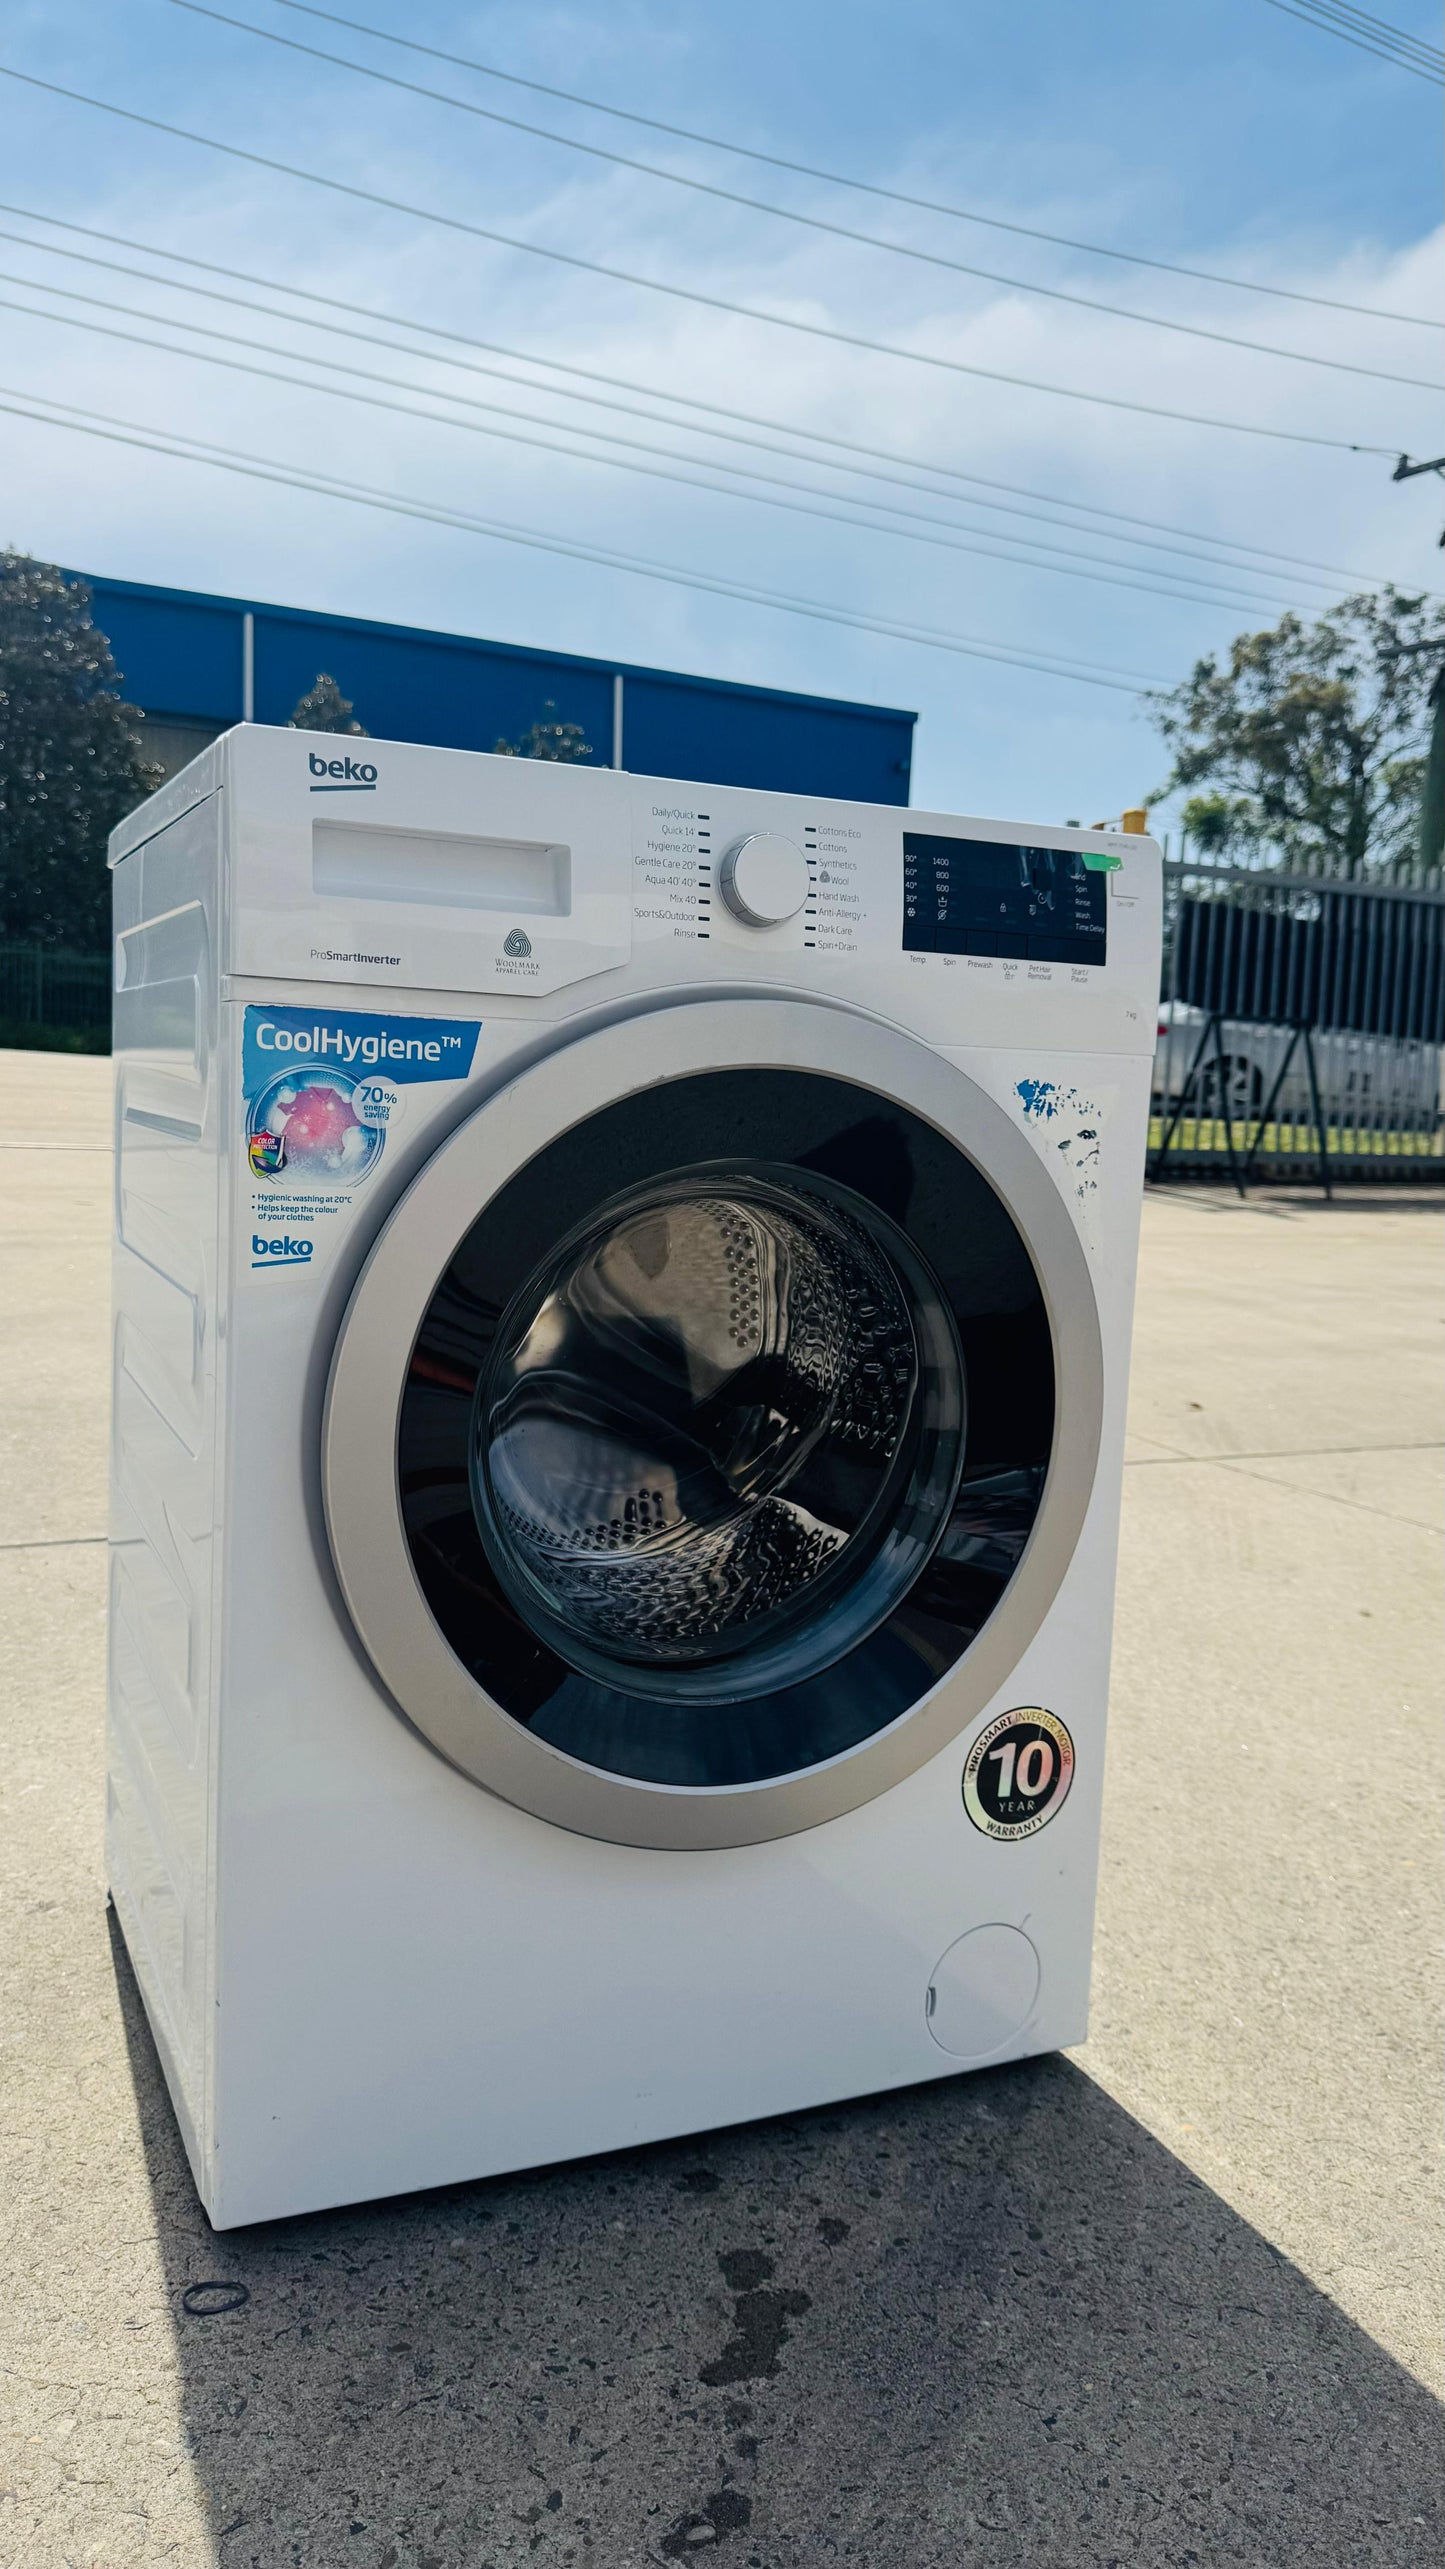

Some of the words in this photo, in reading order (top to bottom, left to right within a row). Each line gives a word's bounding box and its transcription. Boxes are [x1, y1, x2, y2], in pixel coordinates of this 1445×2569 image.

[308, 753, 378, 783] beko
[652, 806, 694, 820] Daily/Quick
[661, 824, 683, 836] Quick
[818, 825, 847, 837] Cottons
[848, 829, 861, 839] Eco
[647, 840, 681, 852] Hygiene
[681, 843, 696, 853] 20°
[818, 841, 848, 853] Cottons
[634, 855, 662, 867] Gentle
[662, 858, 681, 869] Care
[681, 860, 697, 870] 20°
[818, 857, 858, 871] Synthetics
[932, 857, 950, 867] 1400
[644, 874, 666, 886] Aqua
[831, 875, 850, 886] Wool
[935, 870, 950, 880] 800
[935, 883, 950, 893] 600
[1074, 885, 1088, 894] Spin
[669, 893, 684, 904] Mix
[684, 895, 697, 905] 40
[818, 891, 839, 901] Hand
[839, 893, 860, 903] Wash
[1074, 898, 1091, 907] Rinse
[633, 907, 695, 921] Sports&Outdoor
[818, 907, 861, 921] Anti-Allergy
[1074, 911, 1091, 920] Wash
[673, 927, 696, 939] Rinse
[818, 923, 835, 934] Dark
[835, 925, 853, 936] Care
[1075, 923, 1089, 932] Time
[1089, 924, 1106, 935] Delay
[817, 939, 858, 952] Spin+Drain
[310, 949, 401, 966] ProSmartInverter
[943, 957, 957, 967] Spin
[495, 958, 541, 971] WOOLMARK
[967, 959, 993, 969] Prewash
[1002, 962, 1018, 972] Quick
[1028, 964, 1039, 973] Pet
[495, 967, 521, 976] APPAREL
[523, 968, 539, 977] CARE
[1027, 972, 1052, 982] Removal
[1070, 975, 1088, 984] Pause
[360, 1086, 397, 1105] 70%
[363, 1104, 391, 1113] energy
[363, 1110, 390, 1120] saving
[257, 1137, 276, 1145] COLOR
[257, 1193, 292, 1203] Hygienic
[292, 1195, 325, 1204] washing
[334, 1195, 353, 1204] 20°C
[257, 1204, 280, 1213] Helps
[280, 1204, 300, 1214] keep
[300, 1205, 314, 1213] the
[314, 1206, 338, 1214] colour
[257, 1212, 267, 1220] of
[267, 1213, 285, 1222] your
[286, 1213, 315, 1222] clothes
[252, 1235, 314, 1255] beko
[968, 1716, 1014, 1772] PROSMART
[1015, 1711, 1058, 1732] INVERTER
[1054, 1729, 1072, 1766] MOTOR
[988, 1740, 1054, 1798] 10
[999, 1800, 1036, 1813] YEAR
[986, 1815, 1044, 1837] WARRANTY
